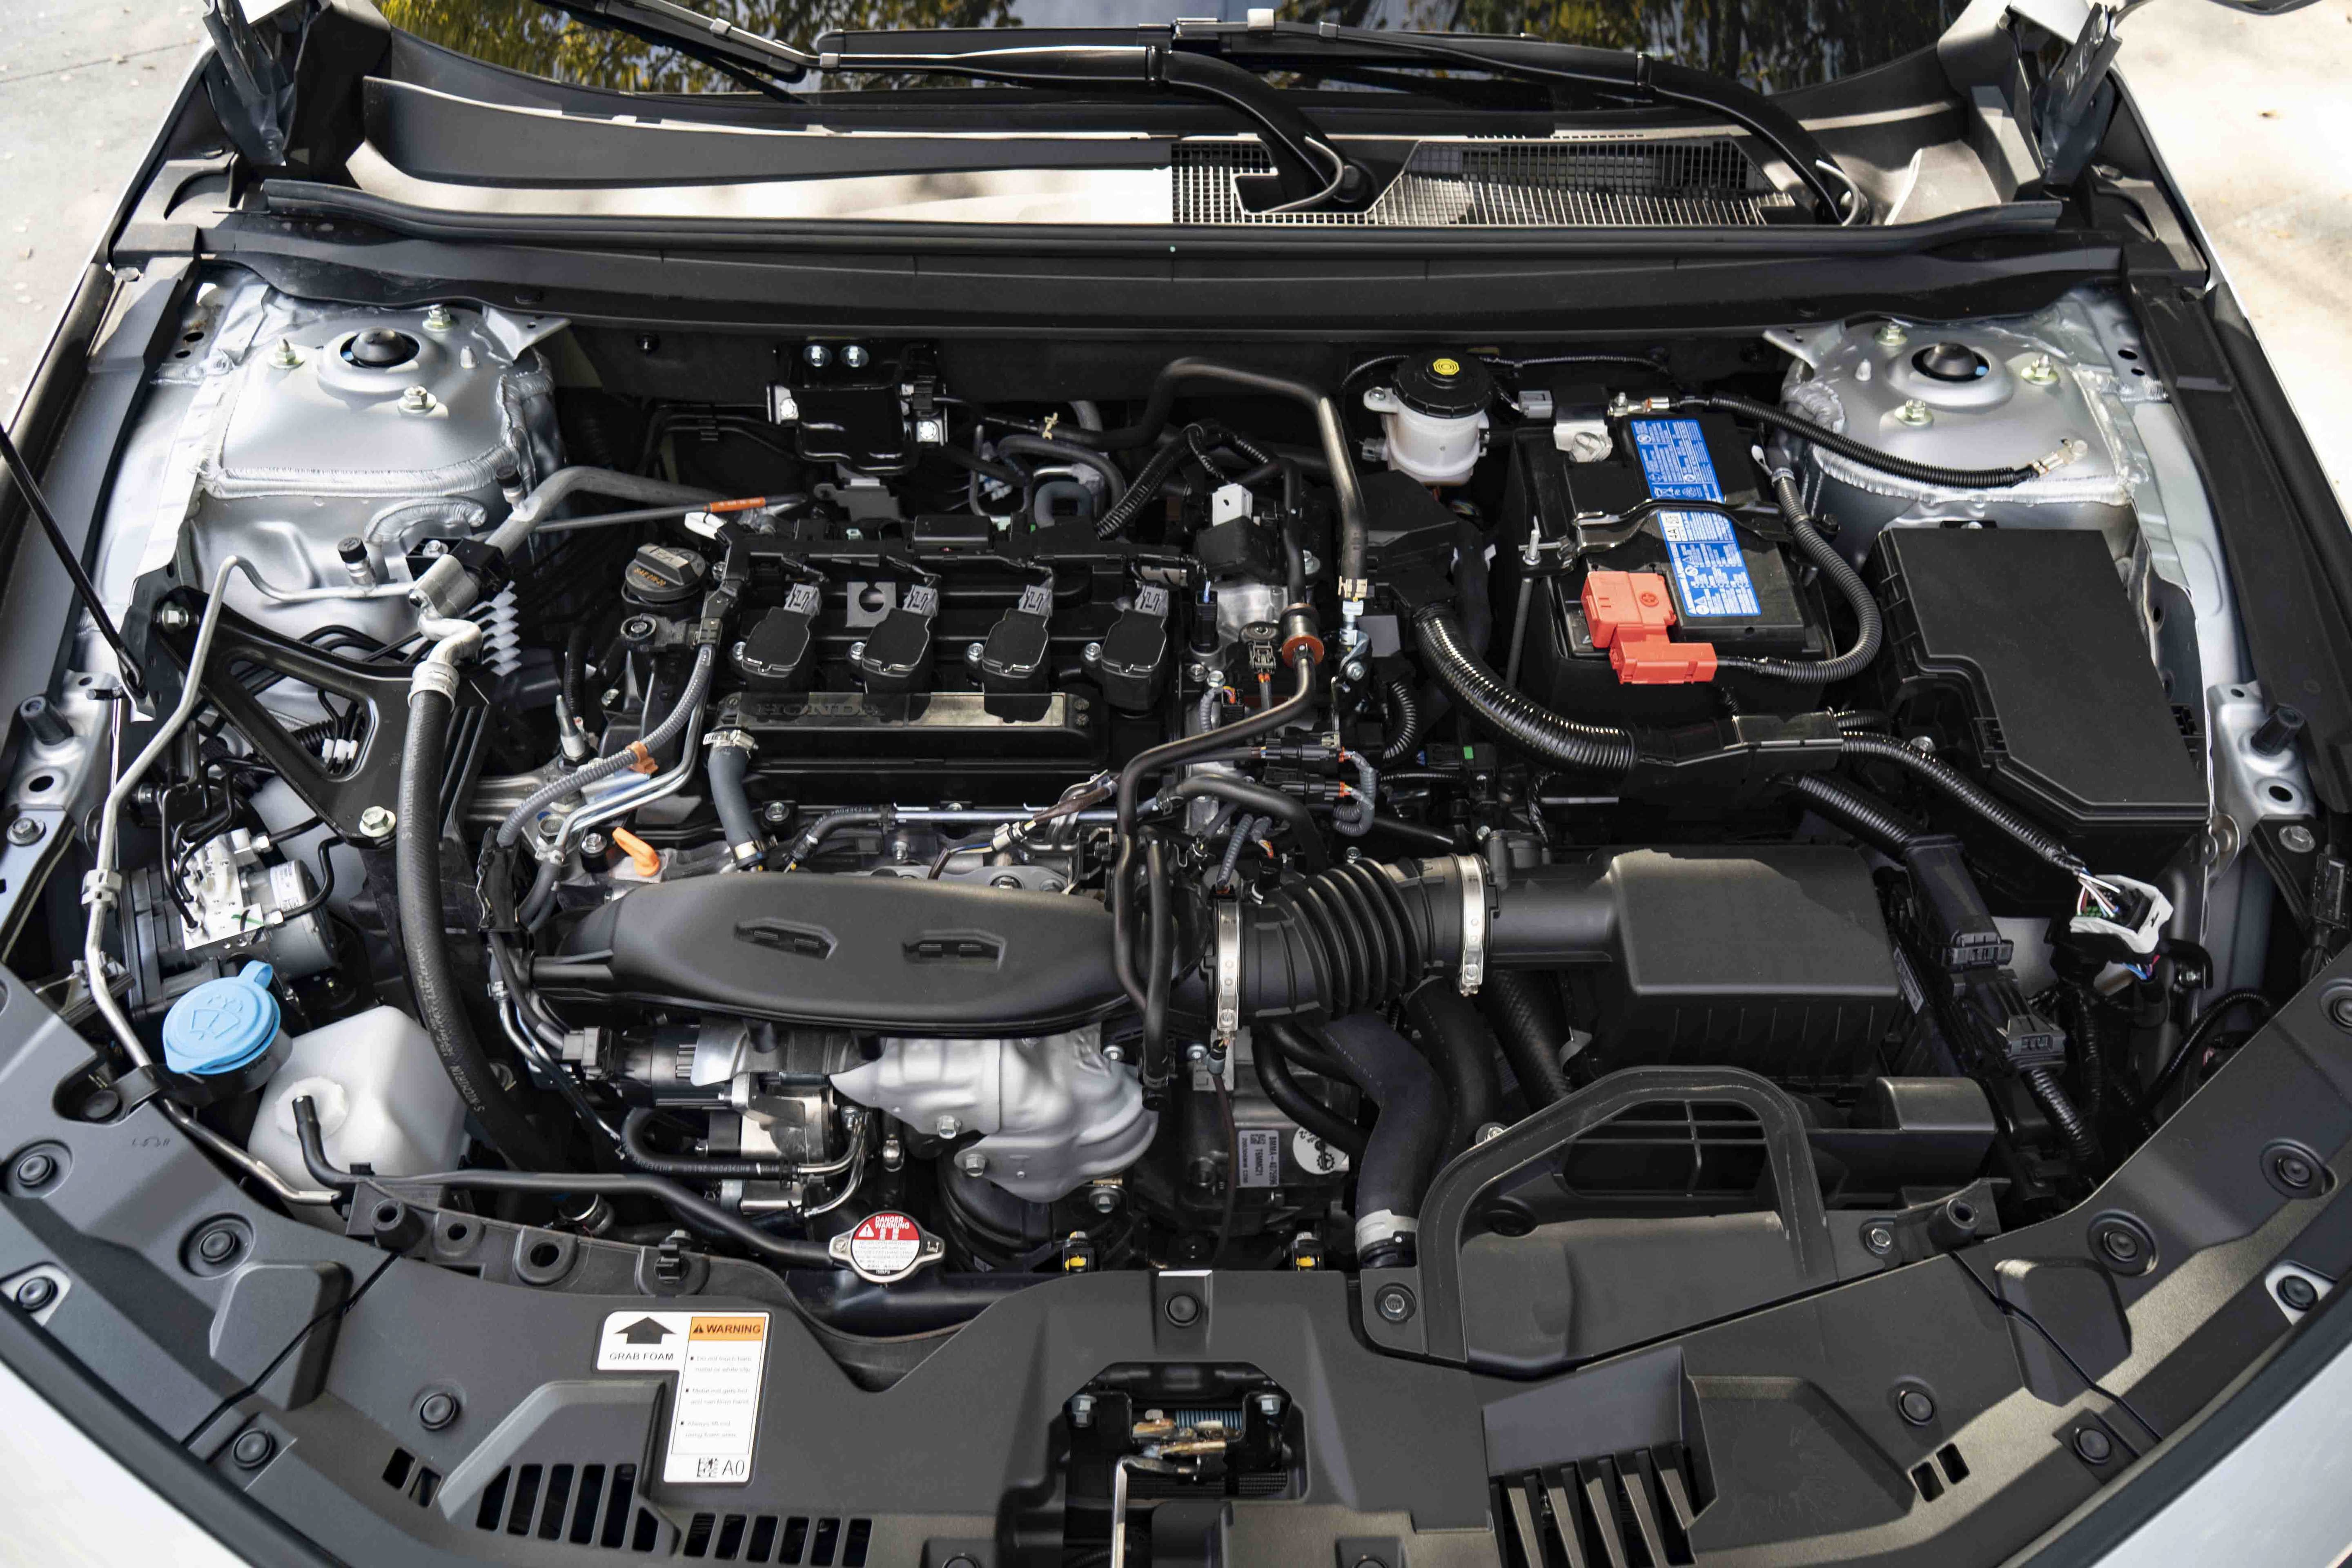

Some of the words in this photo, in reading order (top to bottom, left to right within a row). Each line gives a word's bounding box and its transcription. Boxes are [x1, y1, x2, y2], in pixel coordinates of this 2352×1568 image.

[706, 1324, 761, 1334] WARNING
[609, 1352, 640, 1361] GRAB
[643, 1352, 674, 1361] FOAM
